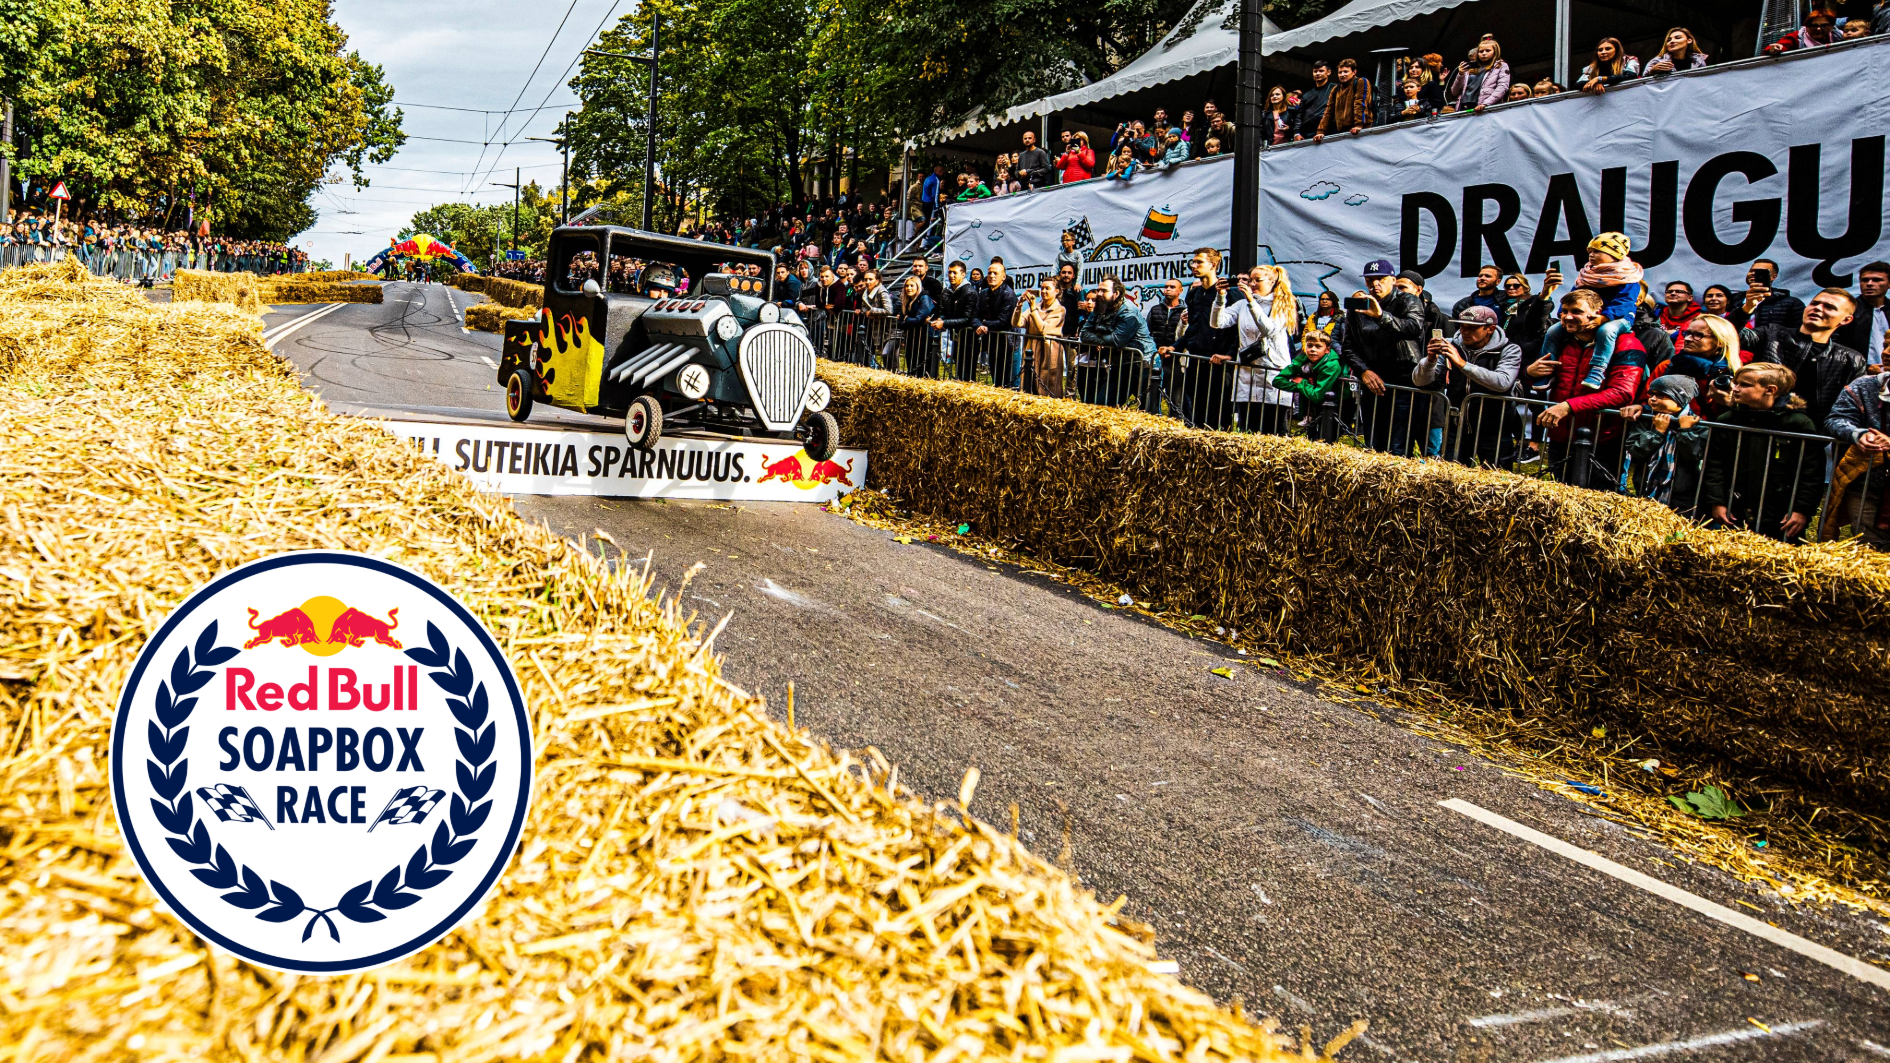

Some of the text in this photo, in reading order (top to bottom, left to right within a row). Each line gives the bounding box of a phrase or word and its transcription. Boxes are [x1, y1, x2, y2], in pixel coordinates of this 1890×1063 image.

[1400, 134, 1885, 289] DRAUGŲ
[1015, 273, 1036, 289] RED
[454, 438, 579, 477] SUTEIKIA
[587, 444, 751, 483] SPARNUUUS.
